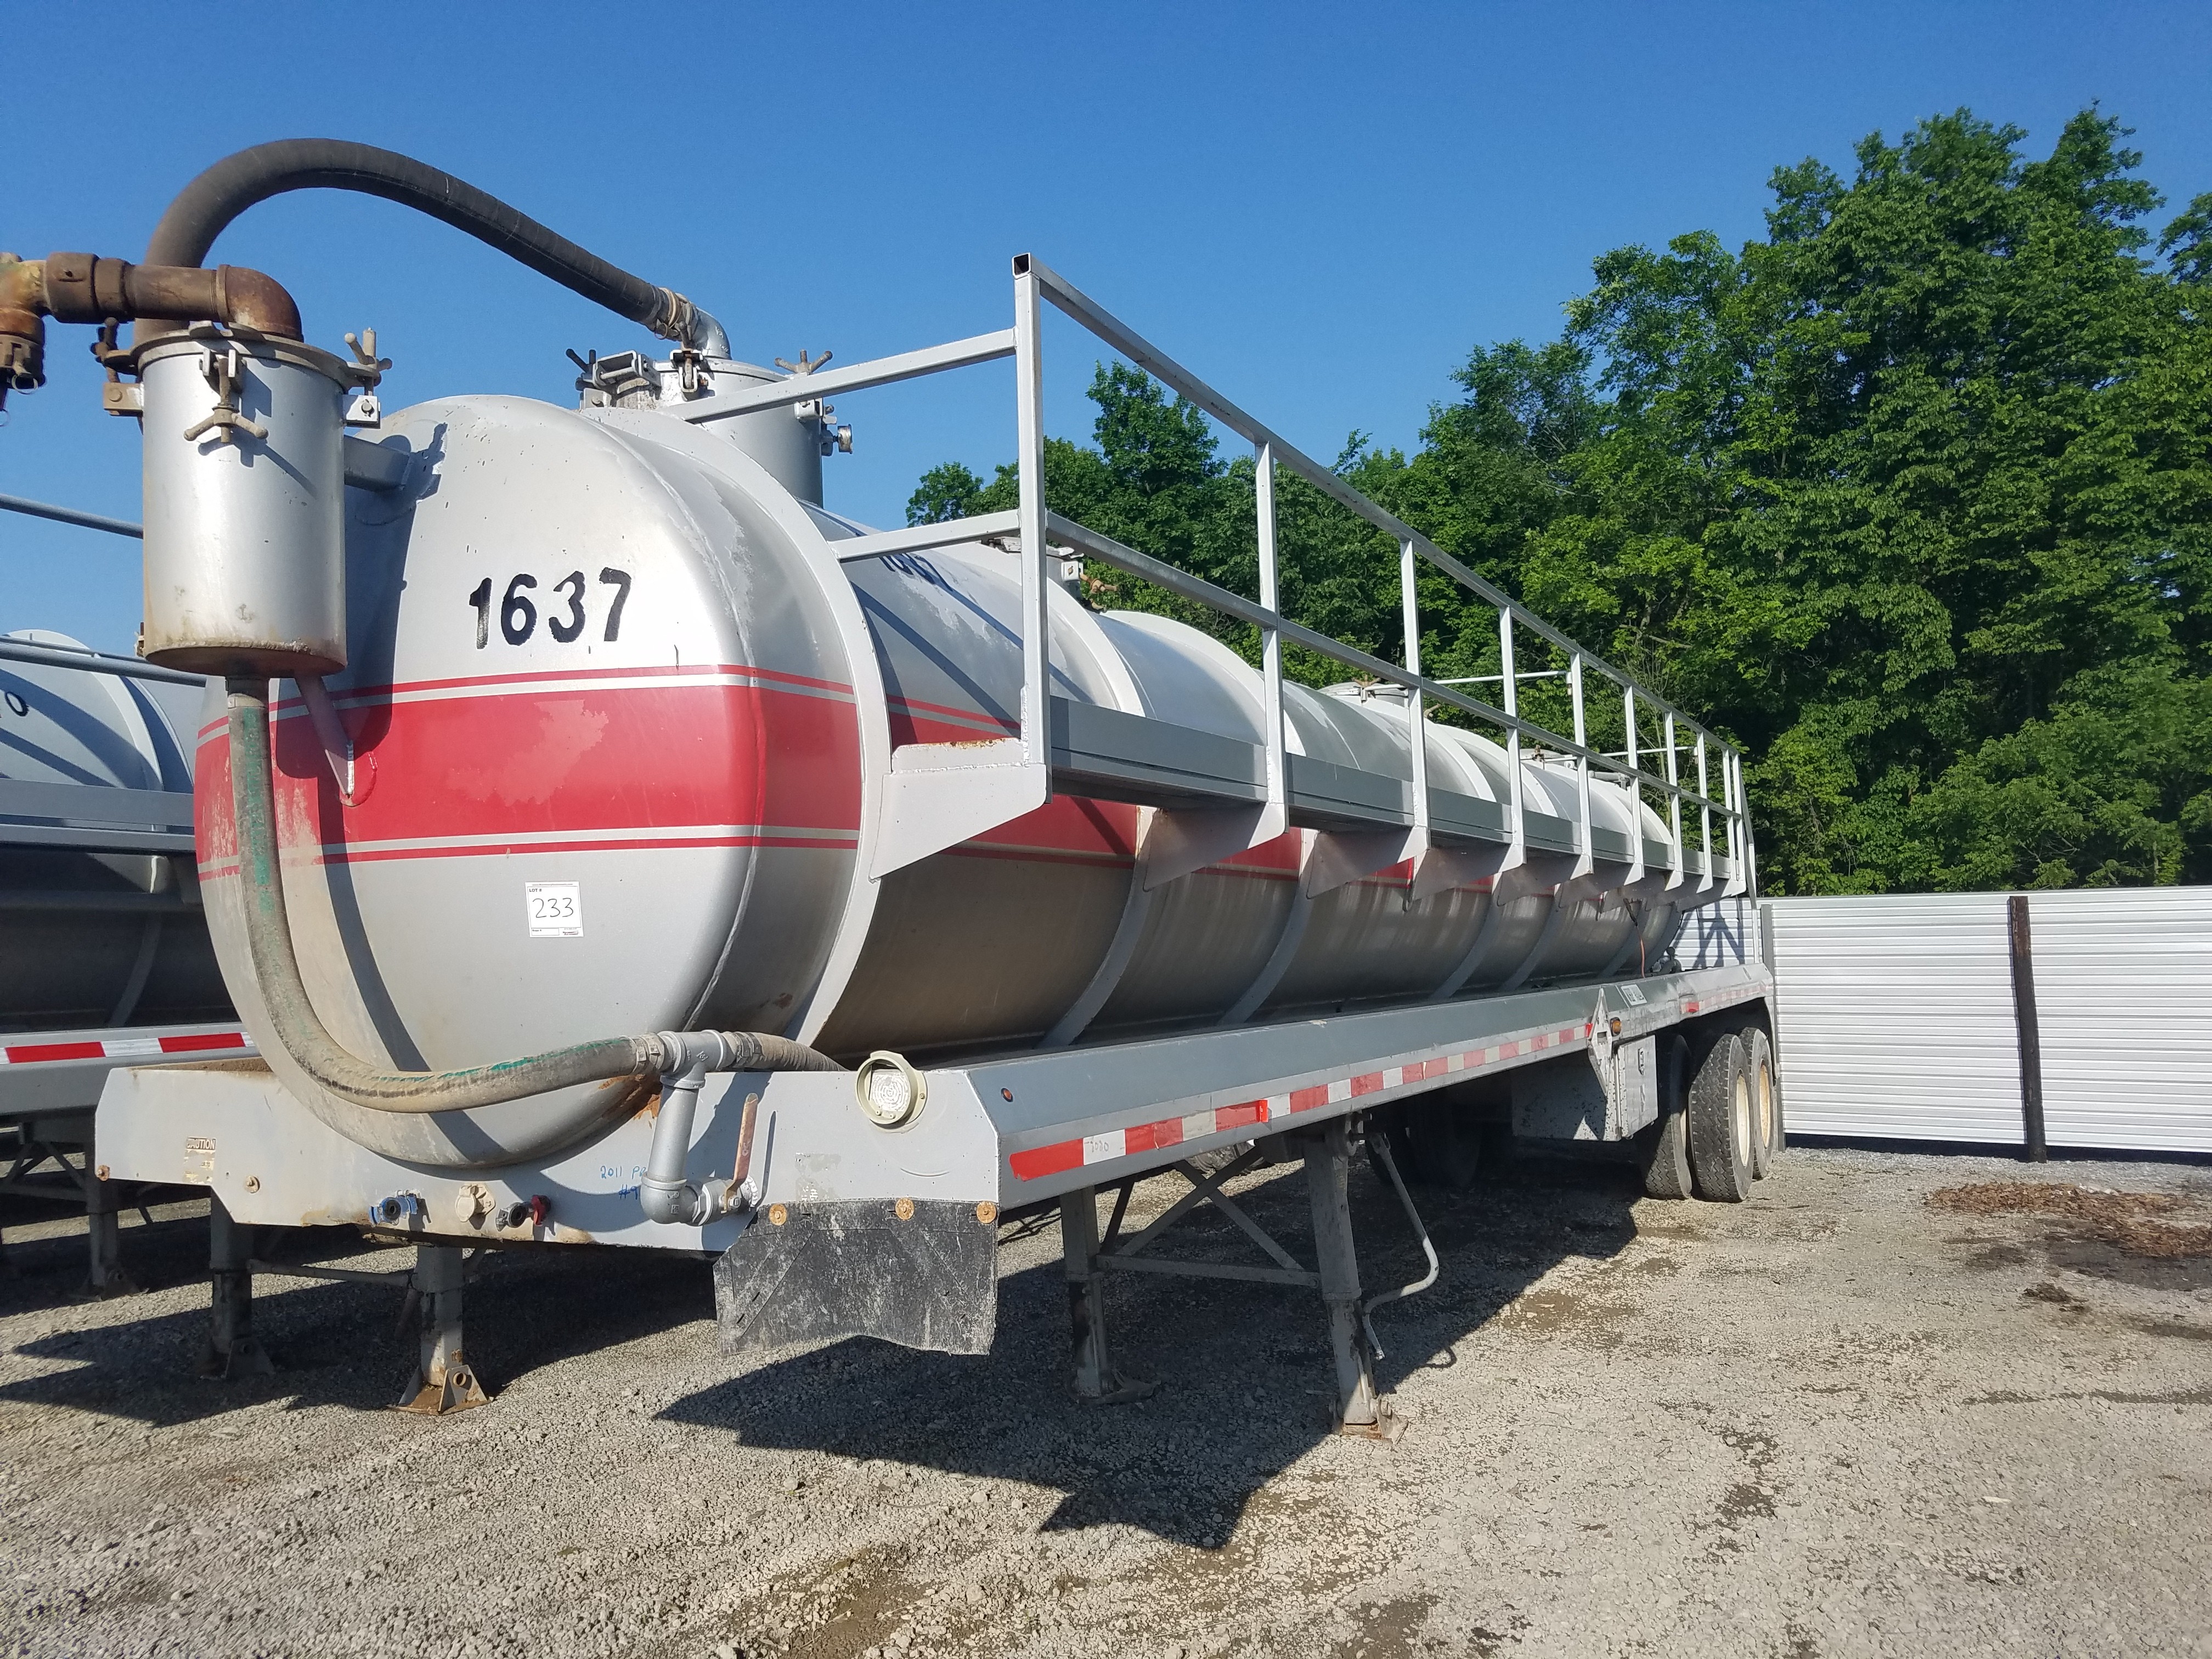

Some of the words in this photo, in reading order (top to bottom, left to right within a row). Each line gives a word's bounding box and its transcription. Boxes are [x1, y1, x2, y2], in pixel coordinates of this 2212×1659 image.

[469, 567, 631, 650] 1637
[532, 898, 574, 918] 233
[600, 1165, 622, 1179] 2011
